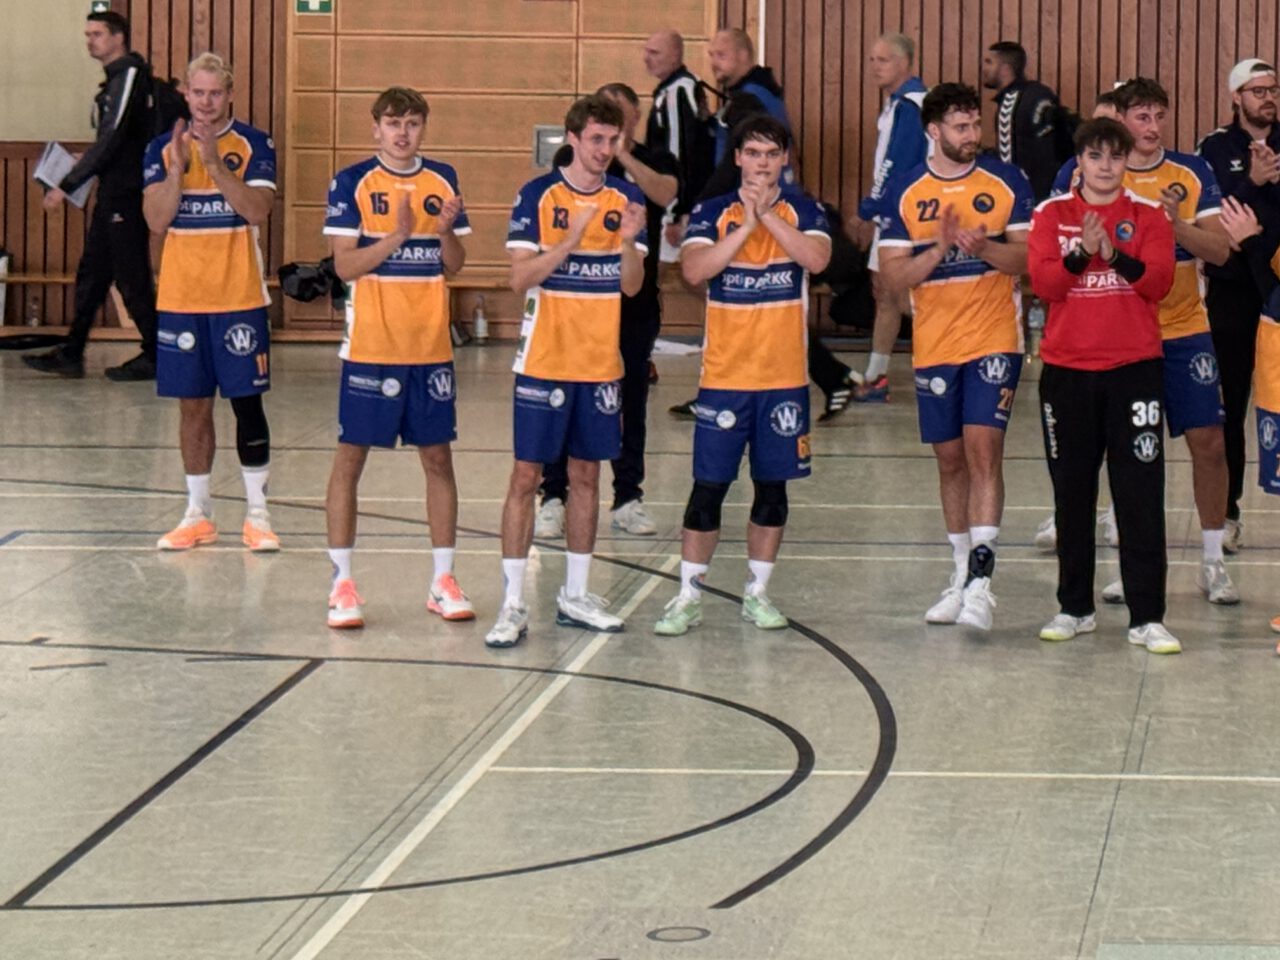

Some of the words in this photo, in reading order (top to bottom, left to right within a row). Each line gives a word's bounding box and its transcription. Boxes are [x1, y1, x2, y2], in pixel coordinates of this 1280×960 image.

[369, 191, 390, 216] 15
[916, 198, 941, 223] 22
[1130, 400, 1161, 427] 36
